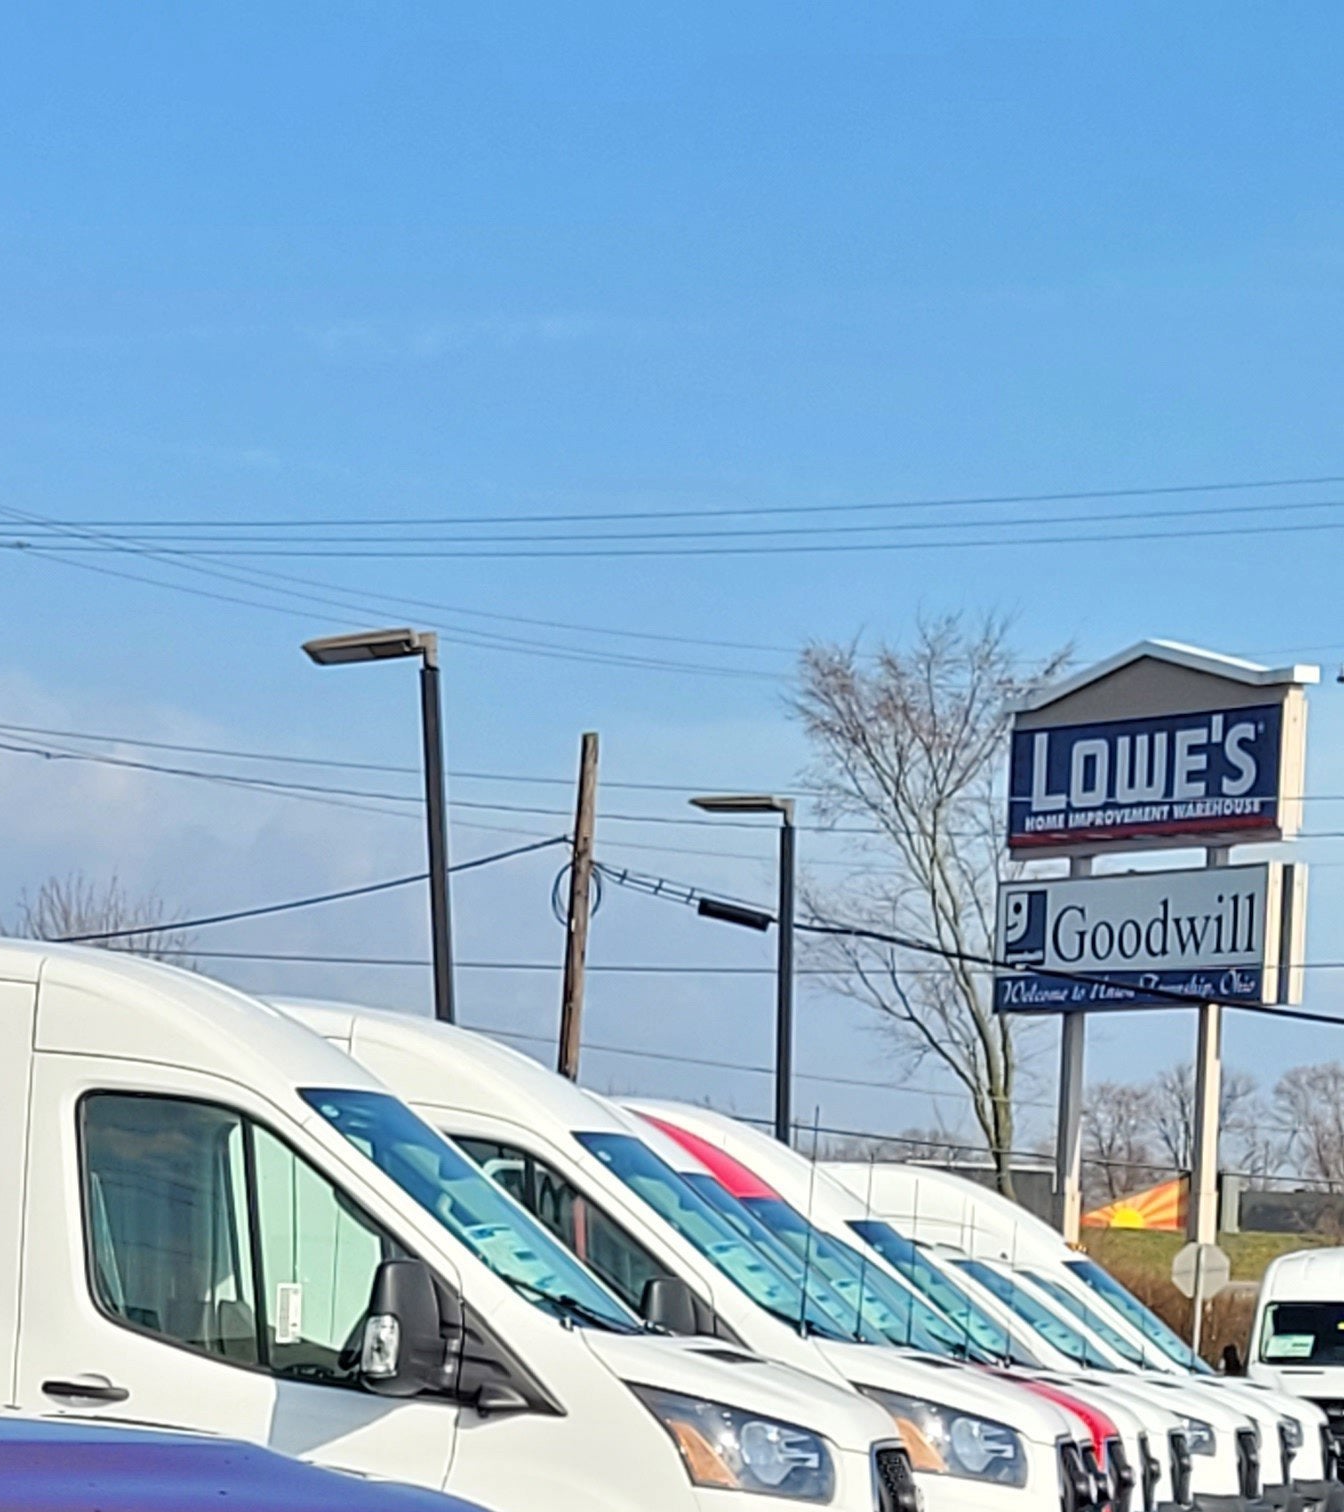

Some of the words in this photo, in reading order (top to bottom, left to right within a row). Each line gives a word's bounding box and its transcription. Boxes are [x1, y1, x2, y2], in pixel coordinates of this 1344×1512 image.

[1031, 714, 1257, 812] LOWE'S
[1025, 813, 1066, 832] HOME
[1068, 805, 1171, 829] IMPROVEMENT
[1172, 799, 1261, 820] WAREHOUSE
[1052, 892, 1256, 963] Goodwill
[1002, 980, 1068, 1004] Welcome
[1071, 983, 1086, 1001] to
[1219, 968, 1257, 995] Ohio
